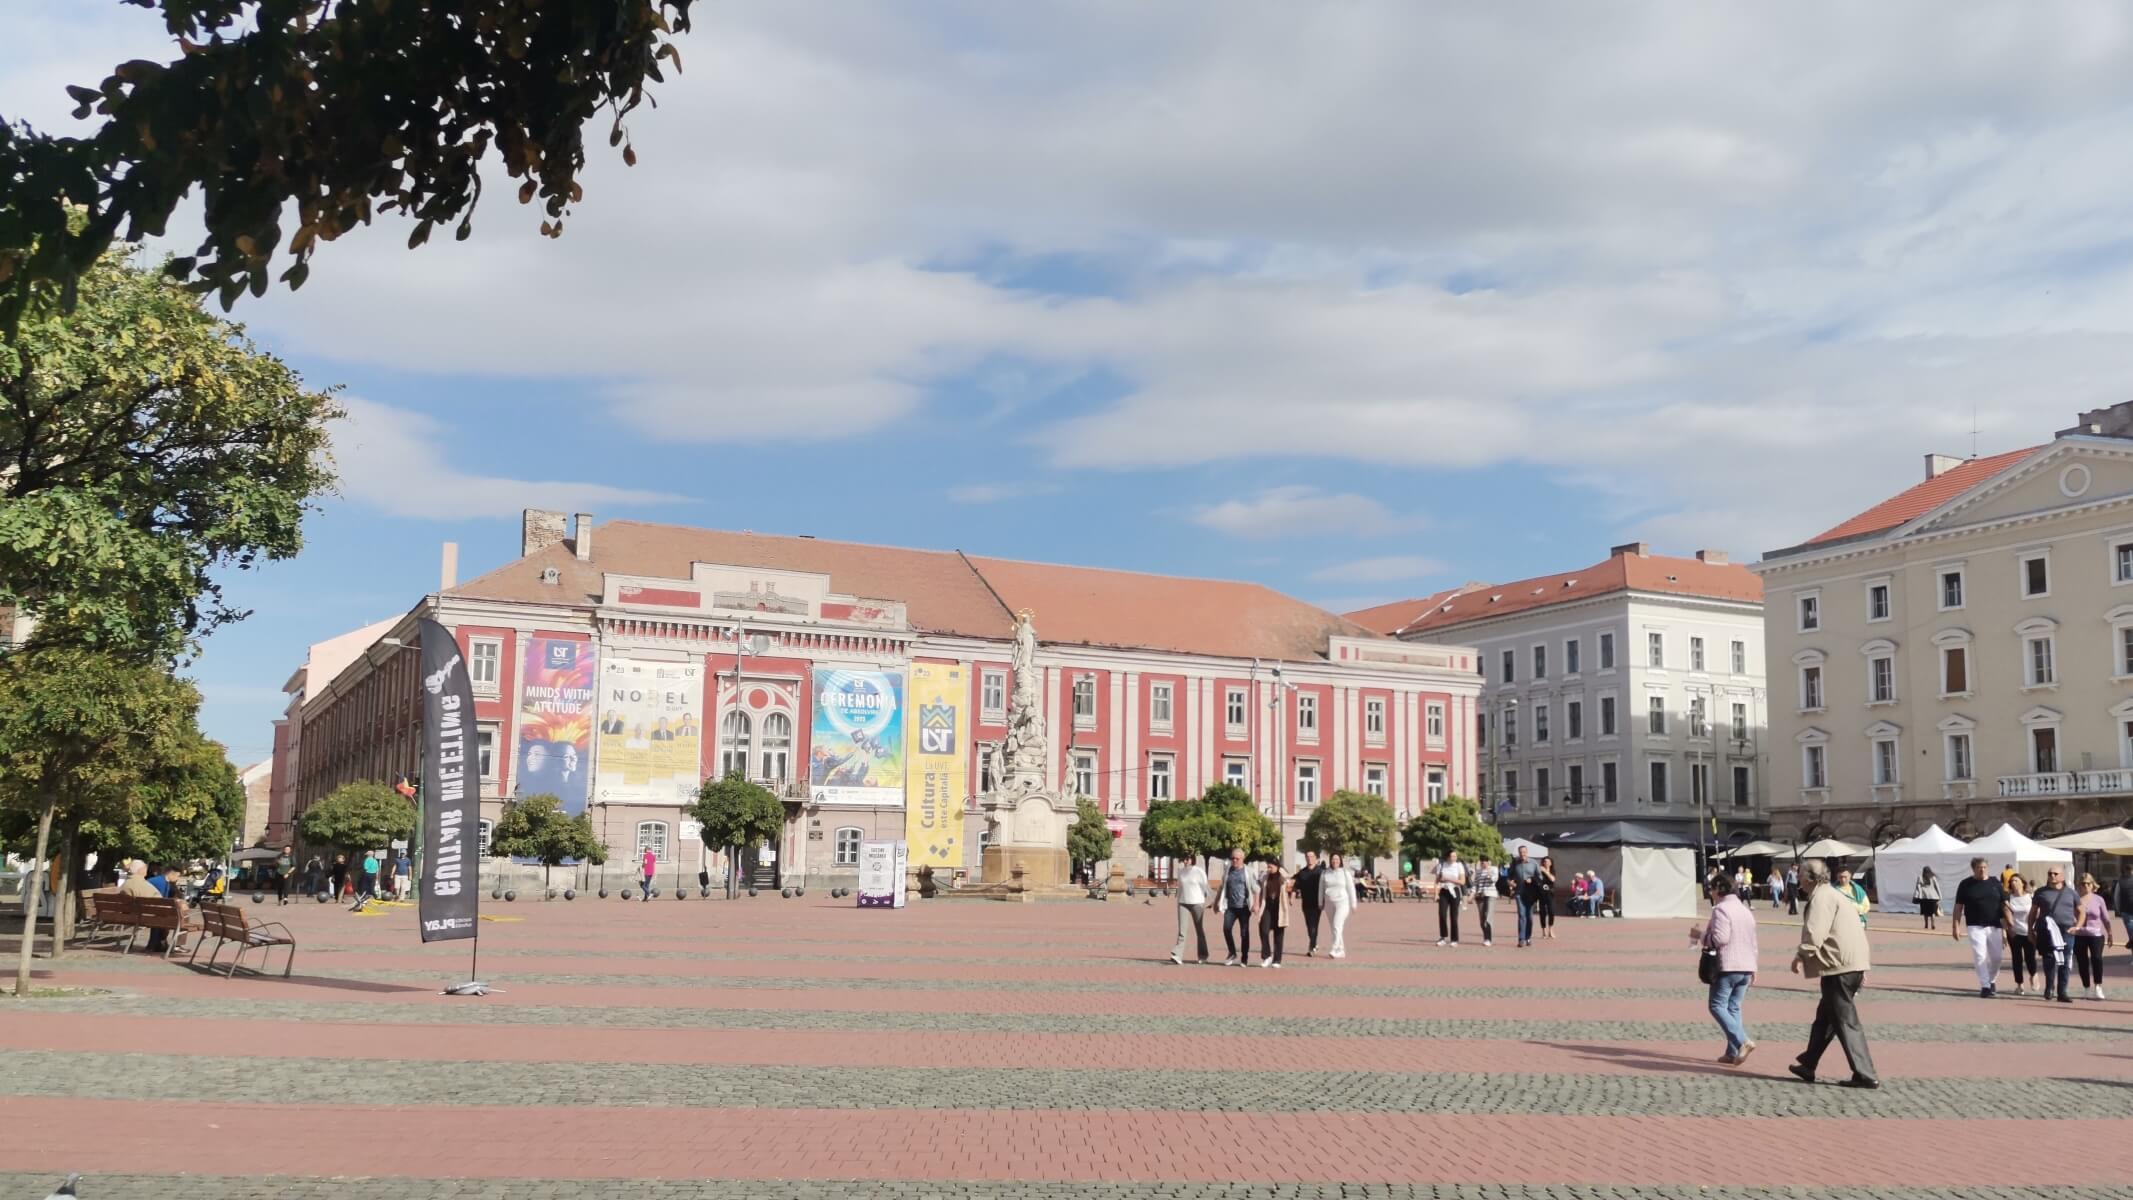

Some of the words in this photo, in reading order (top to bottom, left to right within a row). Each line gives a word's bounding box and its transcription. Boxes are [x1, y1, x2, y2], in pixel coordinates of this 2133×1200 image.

[526, 685, 561, 698] MINDS
[563, 687, 591, 701] WITH
[820, 691, 897, 711] CEREMONIA
[534, 700, 582, 715] ATTITUDE
[920, 772, 936, 829] Cultura
[940, 810, 949, 829] este
